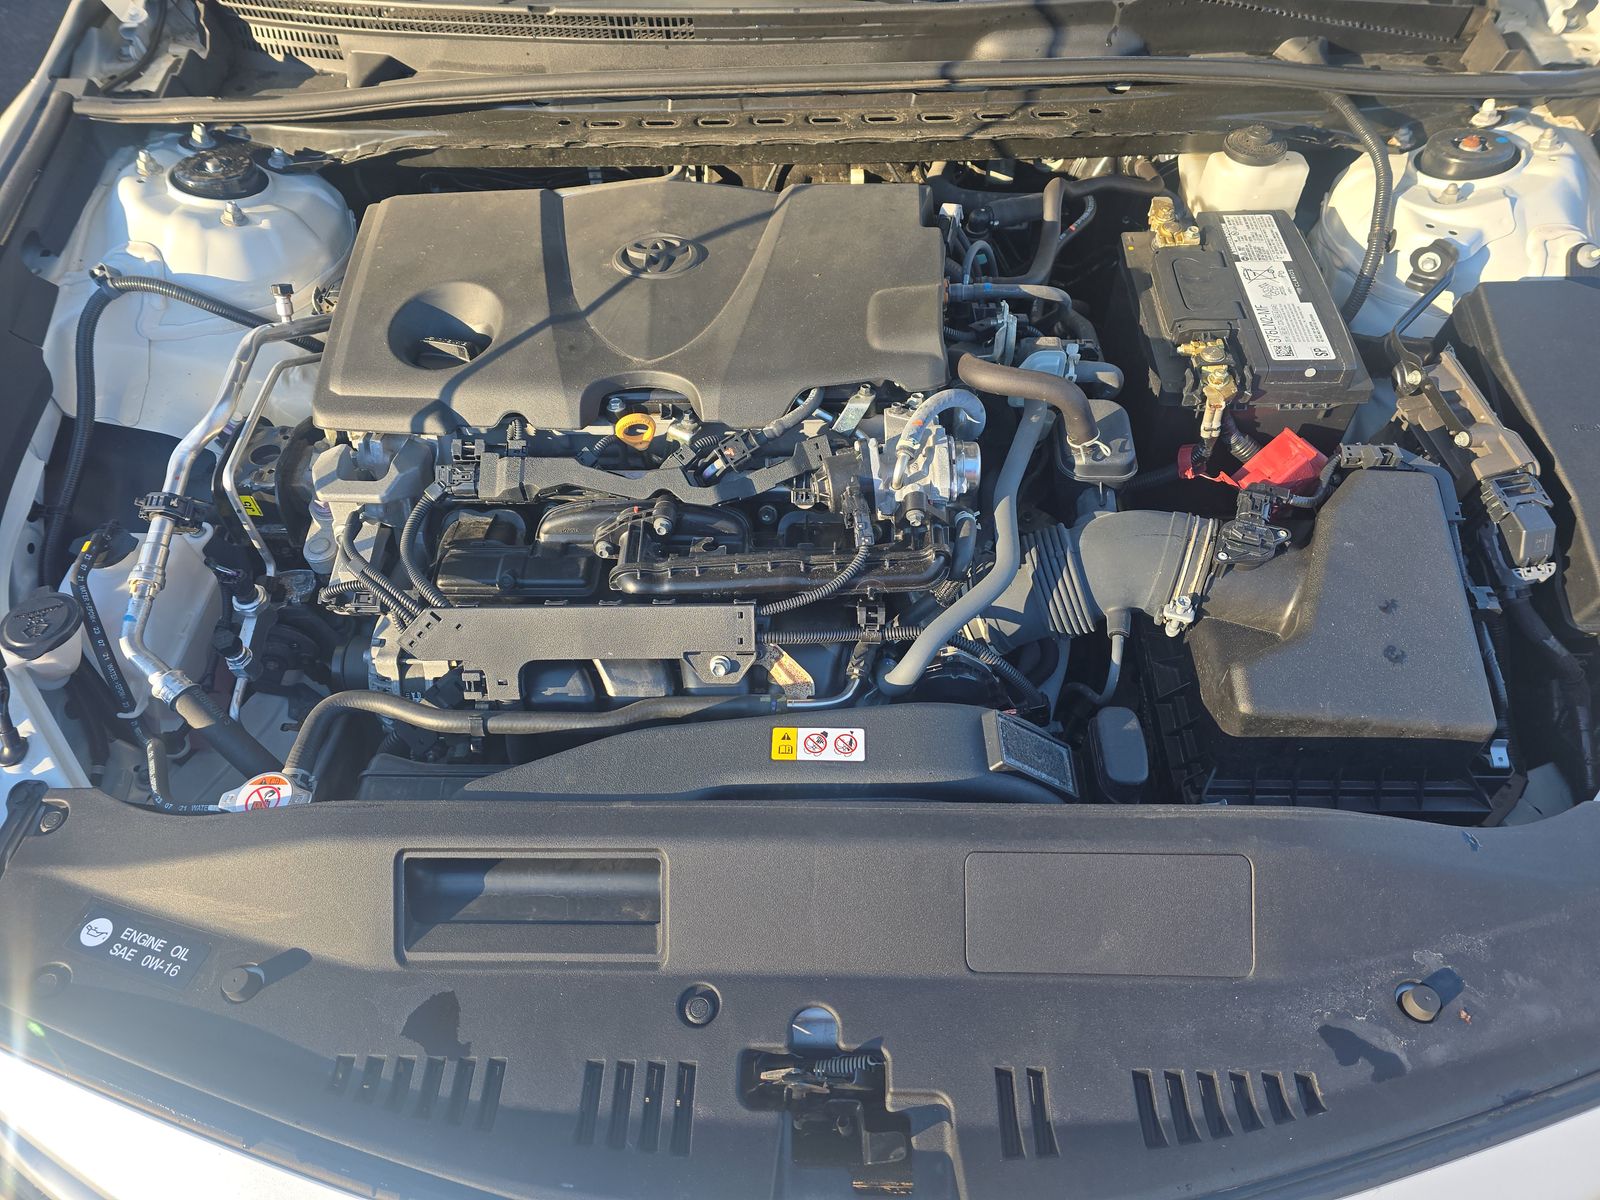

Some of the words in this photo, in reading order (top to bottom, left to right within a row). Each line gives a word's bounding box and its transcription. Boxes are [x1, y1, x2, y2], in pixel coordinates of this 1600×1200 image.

[1313, 347, 1329, 358] SP
[109, 943, 138, 962] SAE
[141, 954, 181, 977] 0W-16
[120, 927, 168, 952] ENGINE
[170, 945, 190, 962] OIL
